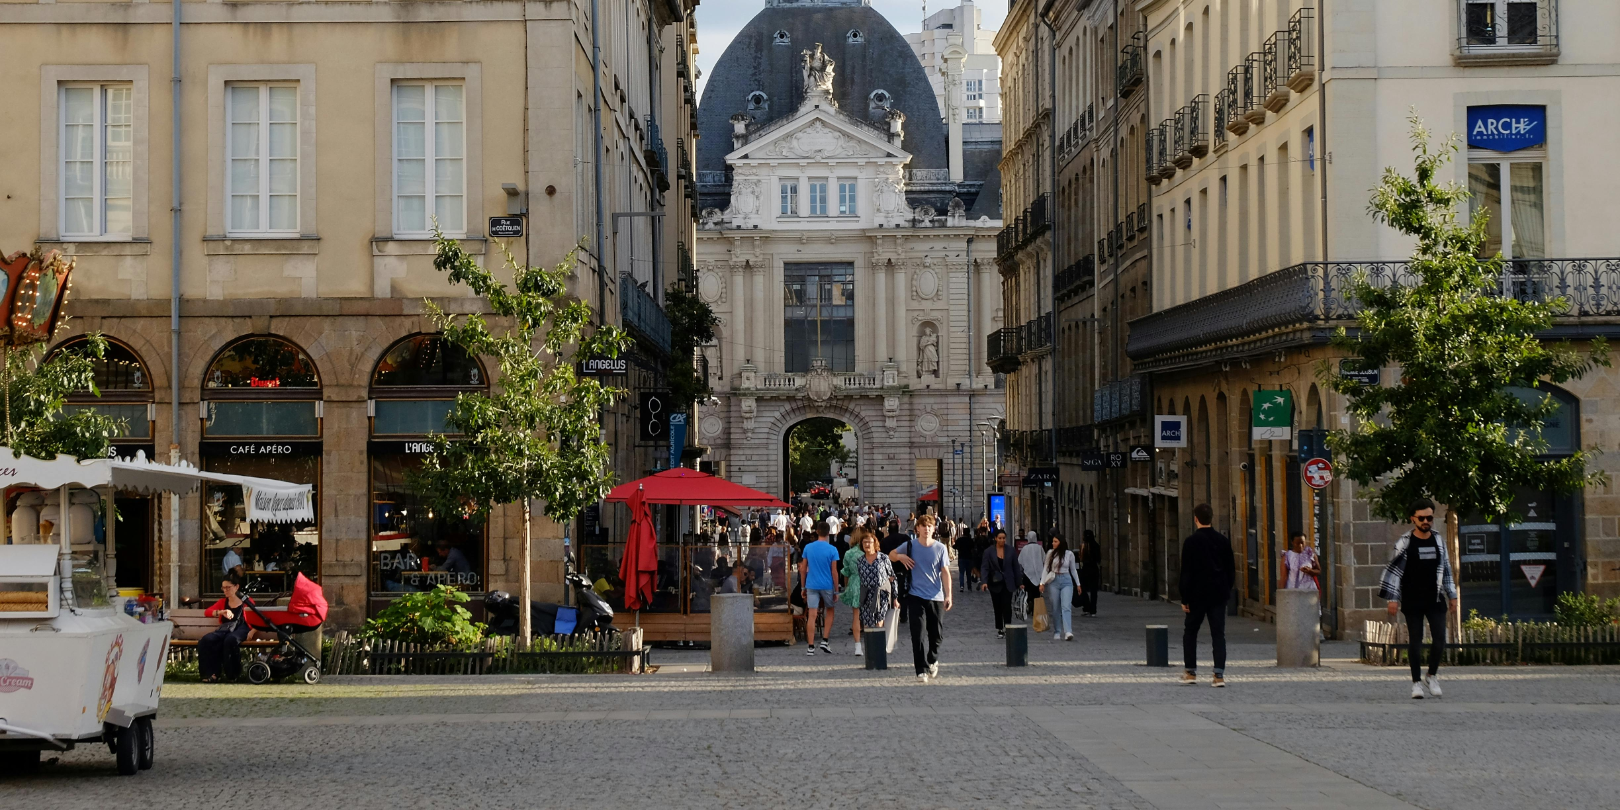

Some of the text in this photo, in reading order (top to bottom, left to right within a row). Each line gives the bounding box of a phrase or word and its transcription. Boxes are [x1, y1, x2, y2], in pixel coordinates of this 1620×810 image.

[230, 444, 292, 454] CAFÉ APÉRO
[380, 553, 418, 570] BAR
[410, 572, 421, 585] &
[1, 677, 33, 687] Cream
